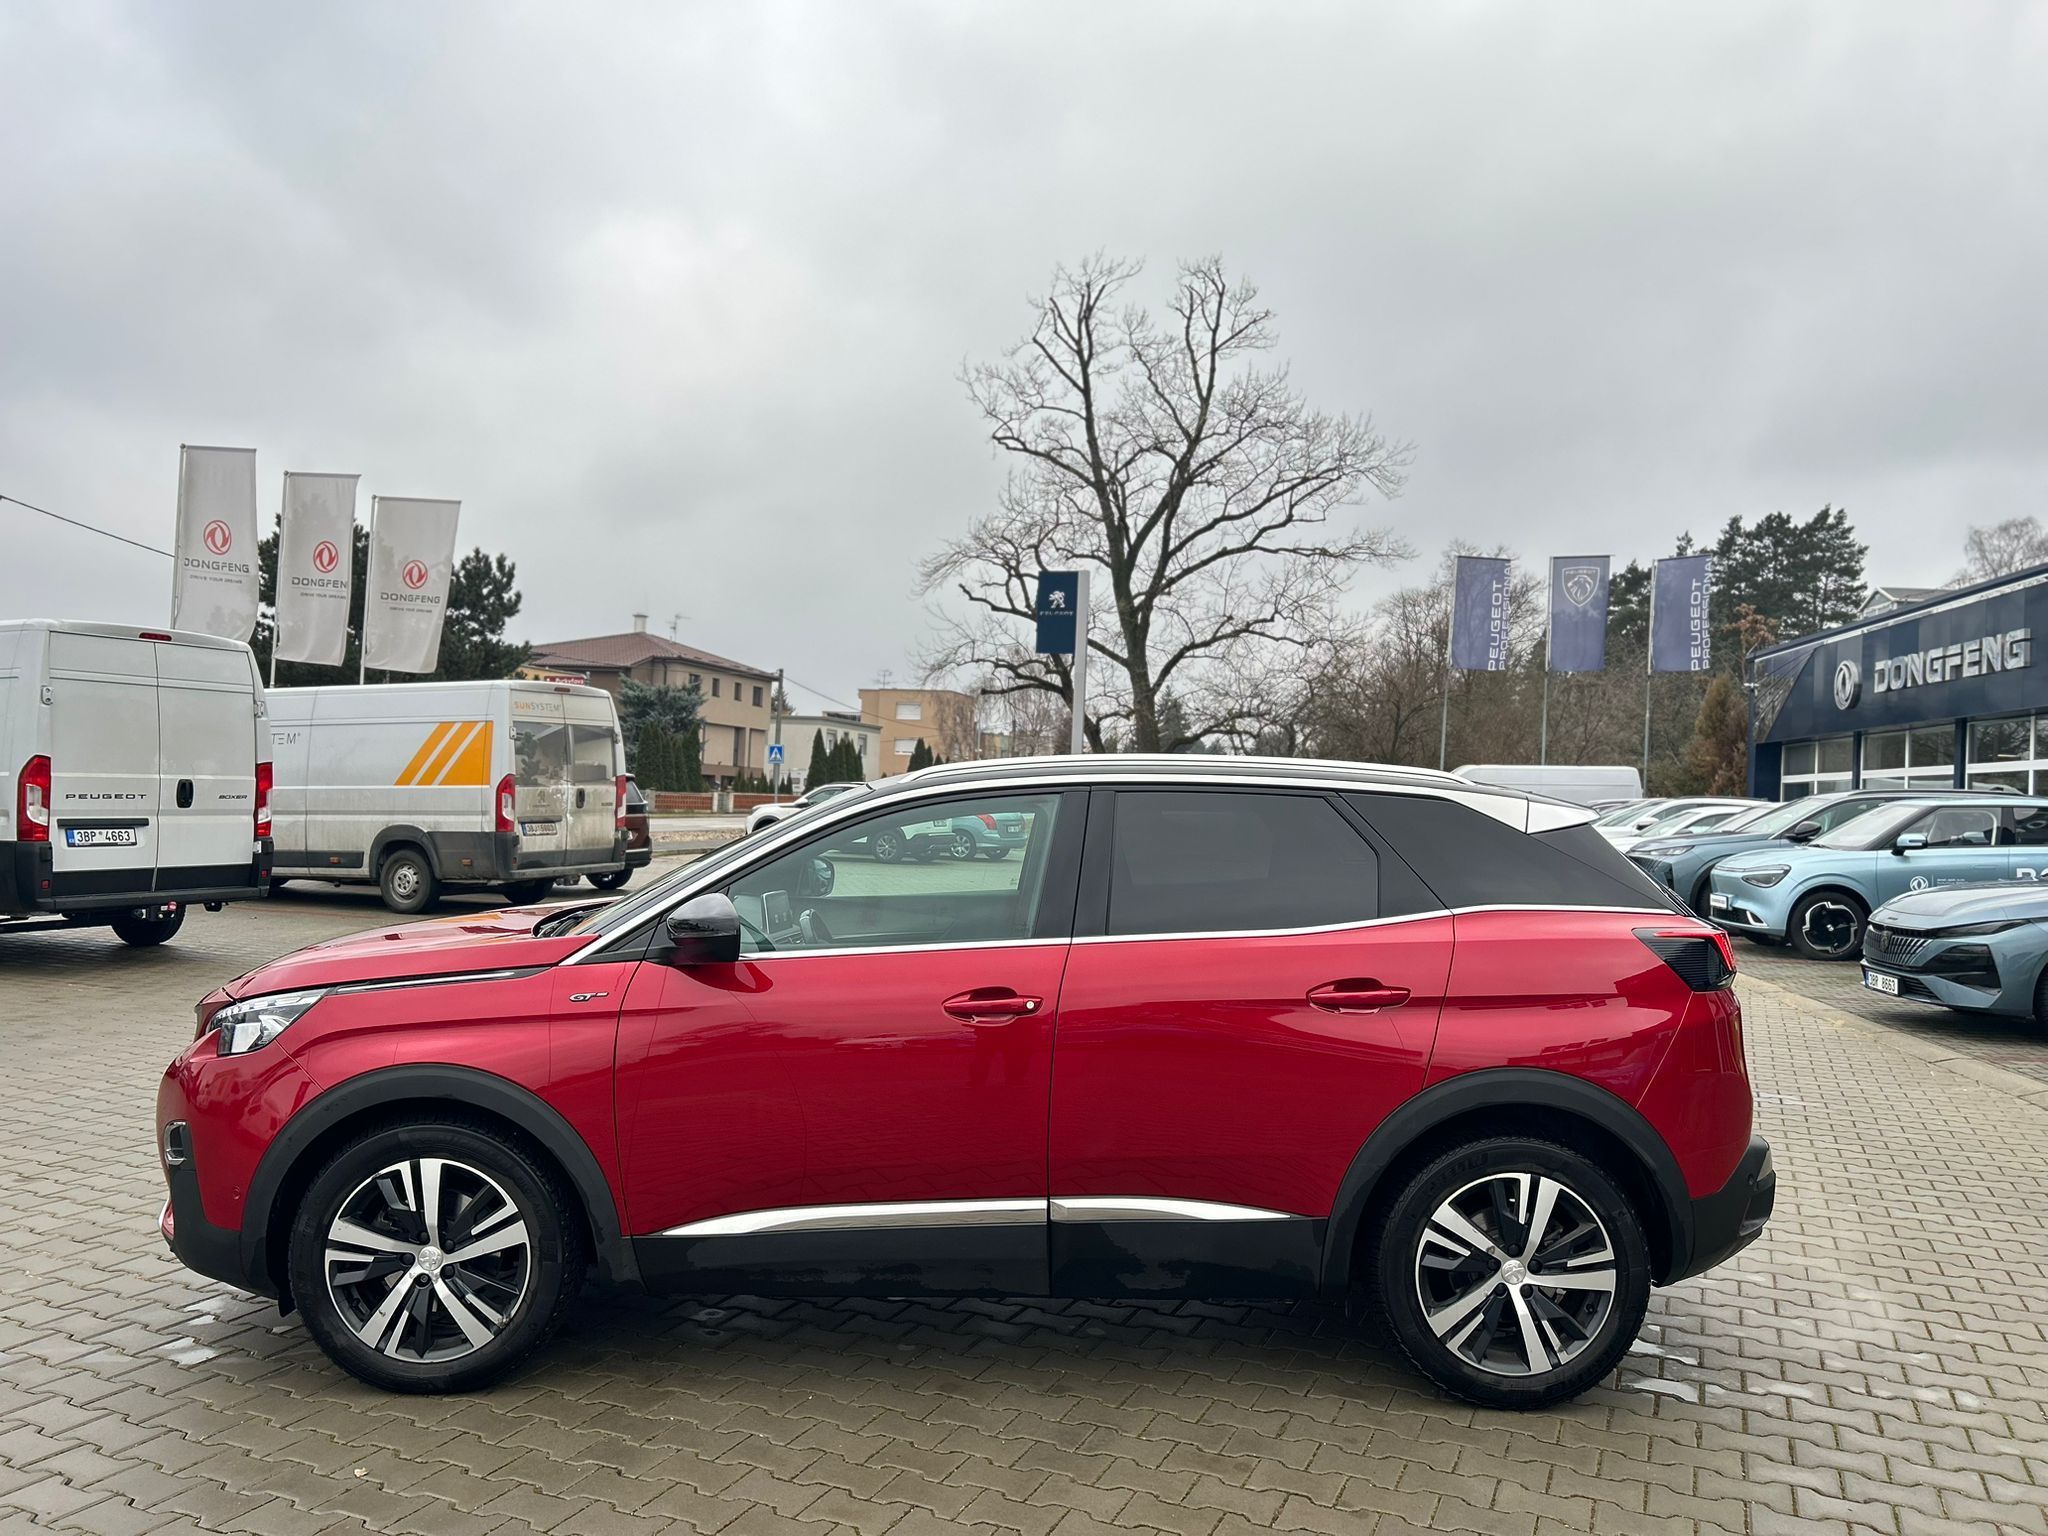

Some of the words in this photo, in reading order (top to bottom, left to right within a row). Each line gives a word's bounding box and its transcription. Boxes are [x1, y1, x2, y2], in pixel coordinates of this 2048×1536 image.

[380, 592, 441, 604] DONGFENG
[1487, 579, 1503, 672] PEUGEOT
[1691, 578, 1702, 672] PEUGEOT
[1873, 627, 2032, 693] DONGFENG
[76, 831, 96, 842] 3BP
[105, 830, 131, 842] 4663
